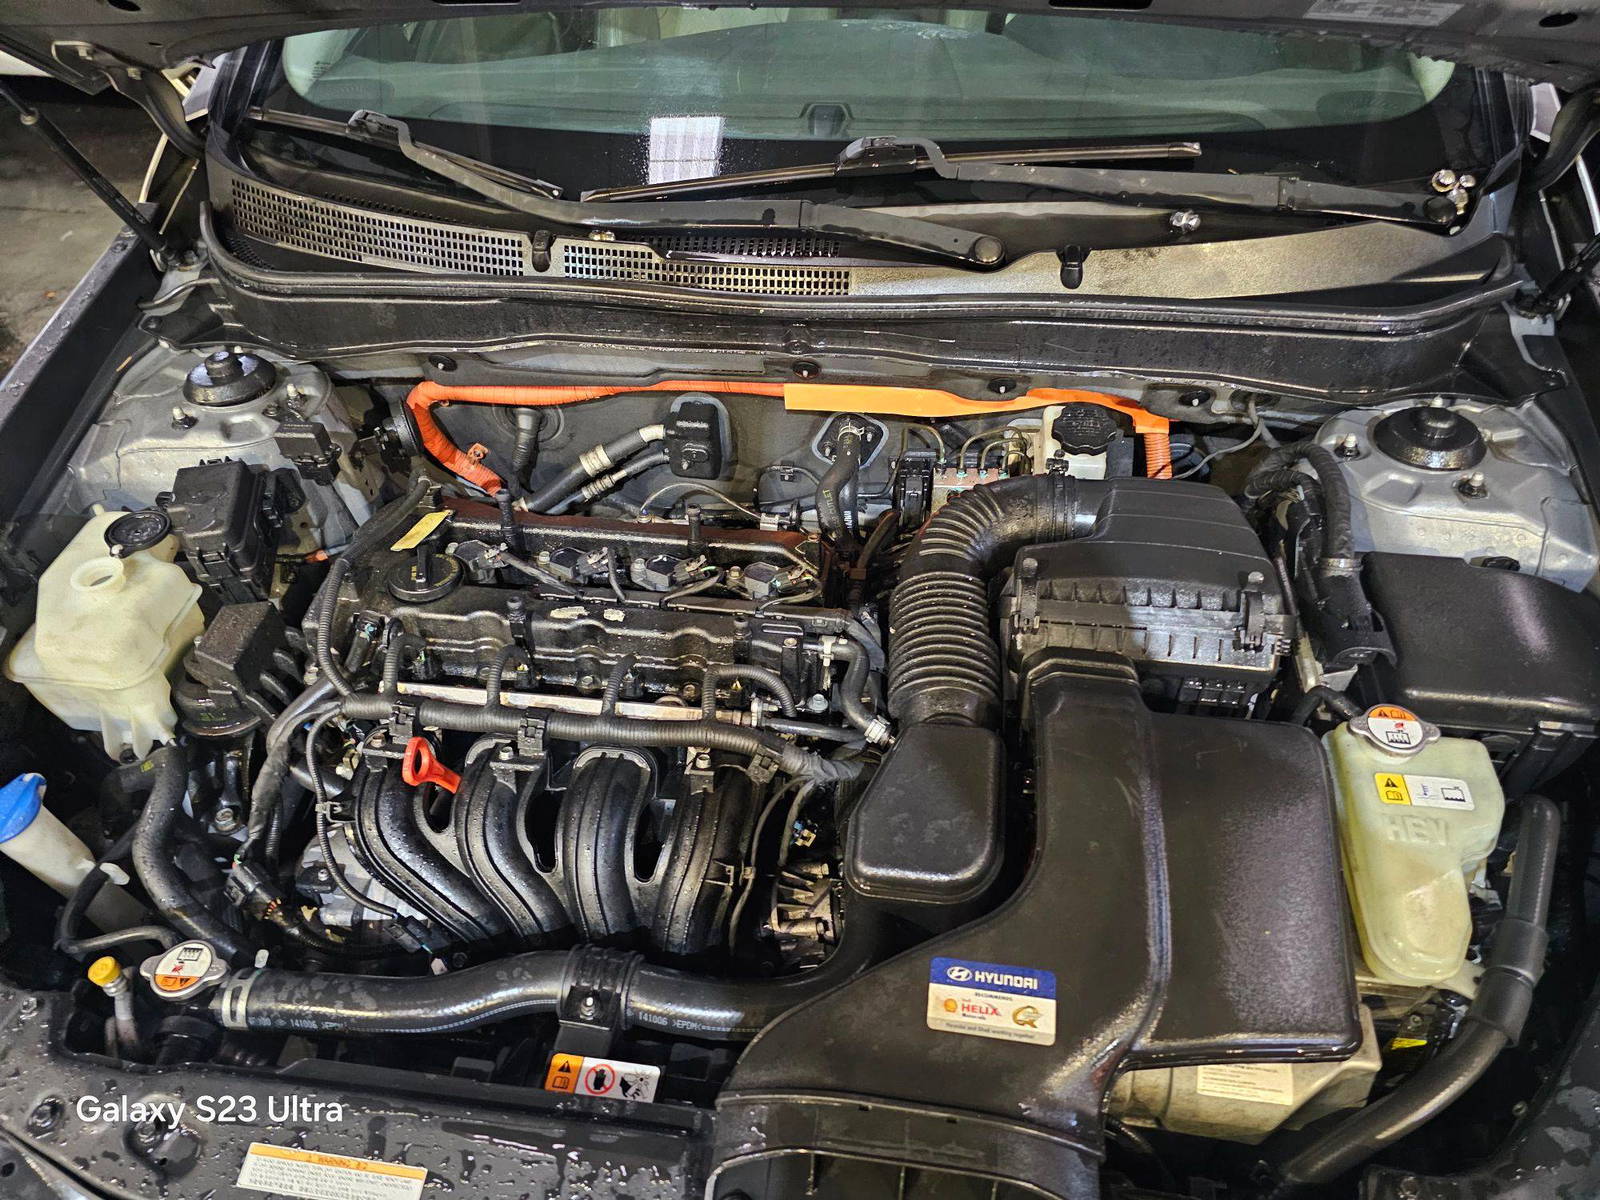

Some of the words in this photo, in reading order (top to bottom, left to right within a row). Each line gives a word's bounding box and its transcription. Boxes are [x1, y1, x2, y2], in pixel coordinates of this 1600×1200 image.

[975, 971, 1038, 989] HYUNDAI
[961, 1003, 1000, 1016] HELIX
[639, 1012, 667, 1026] 141006
